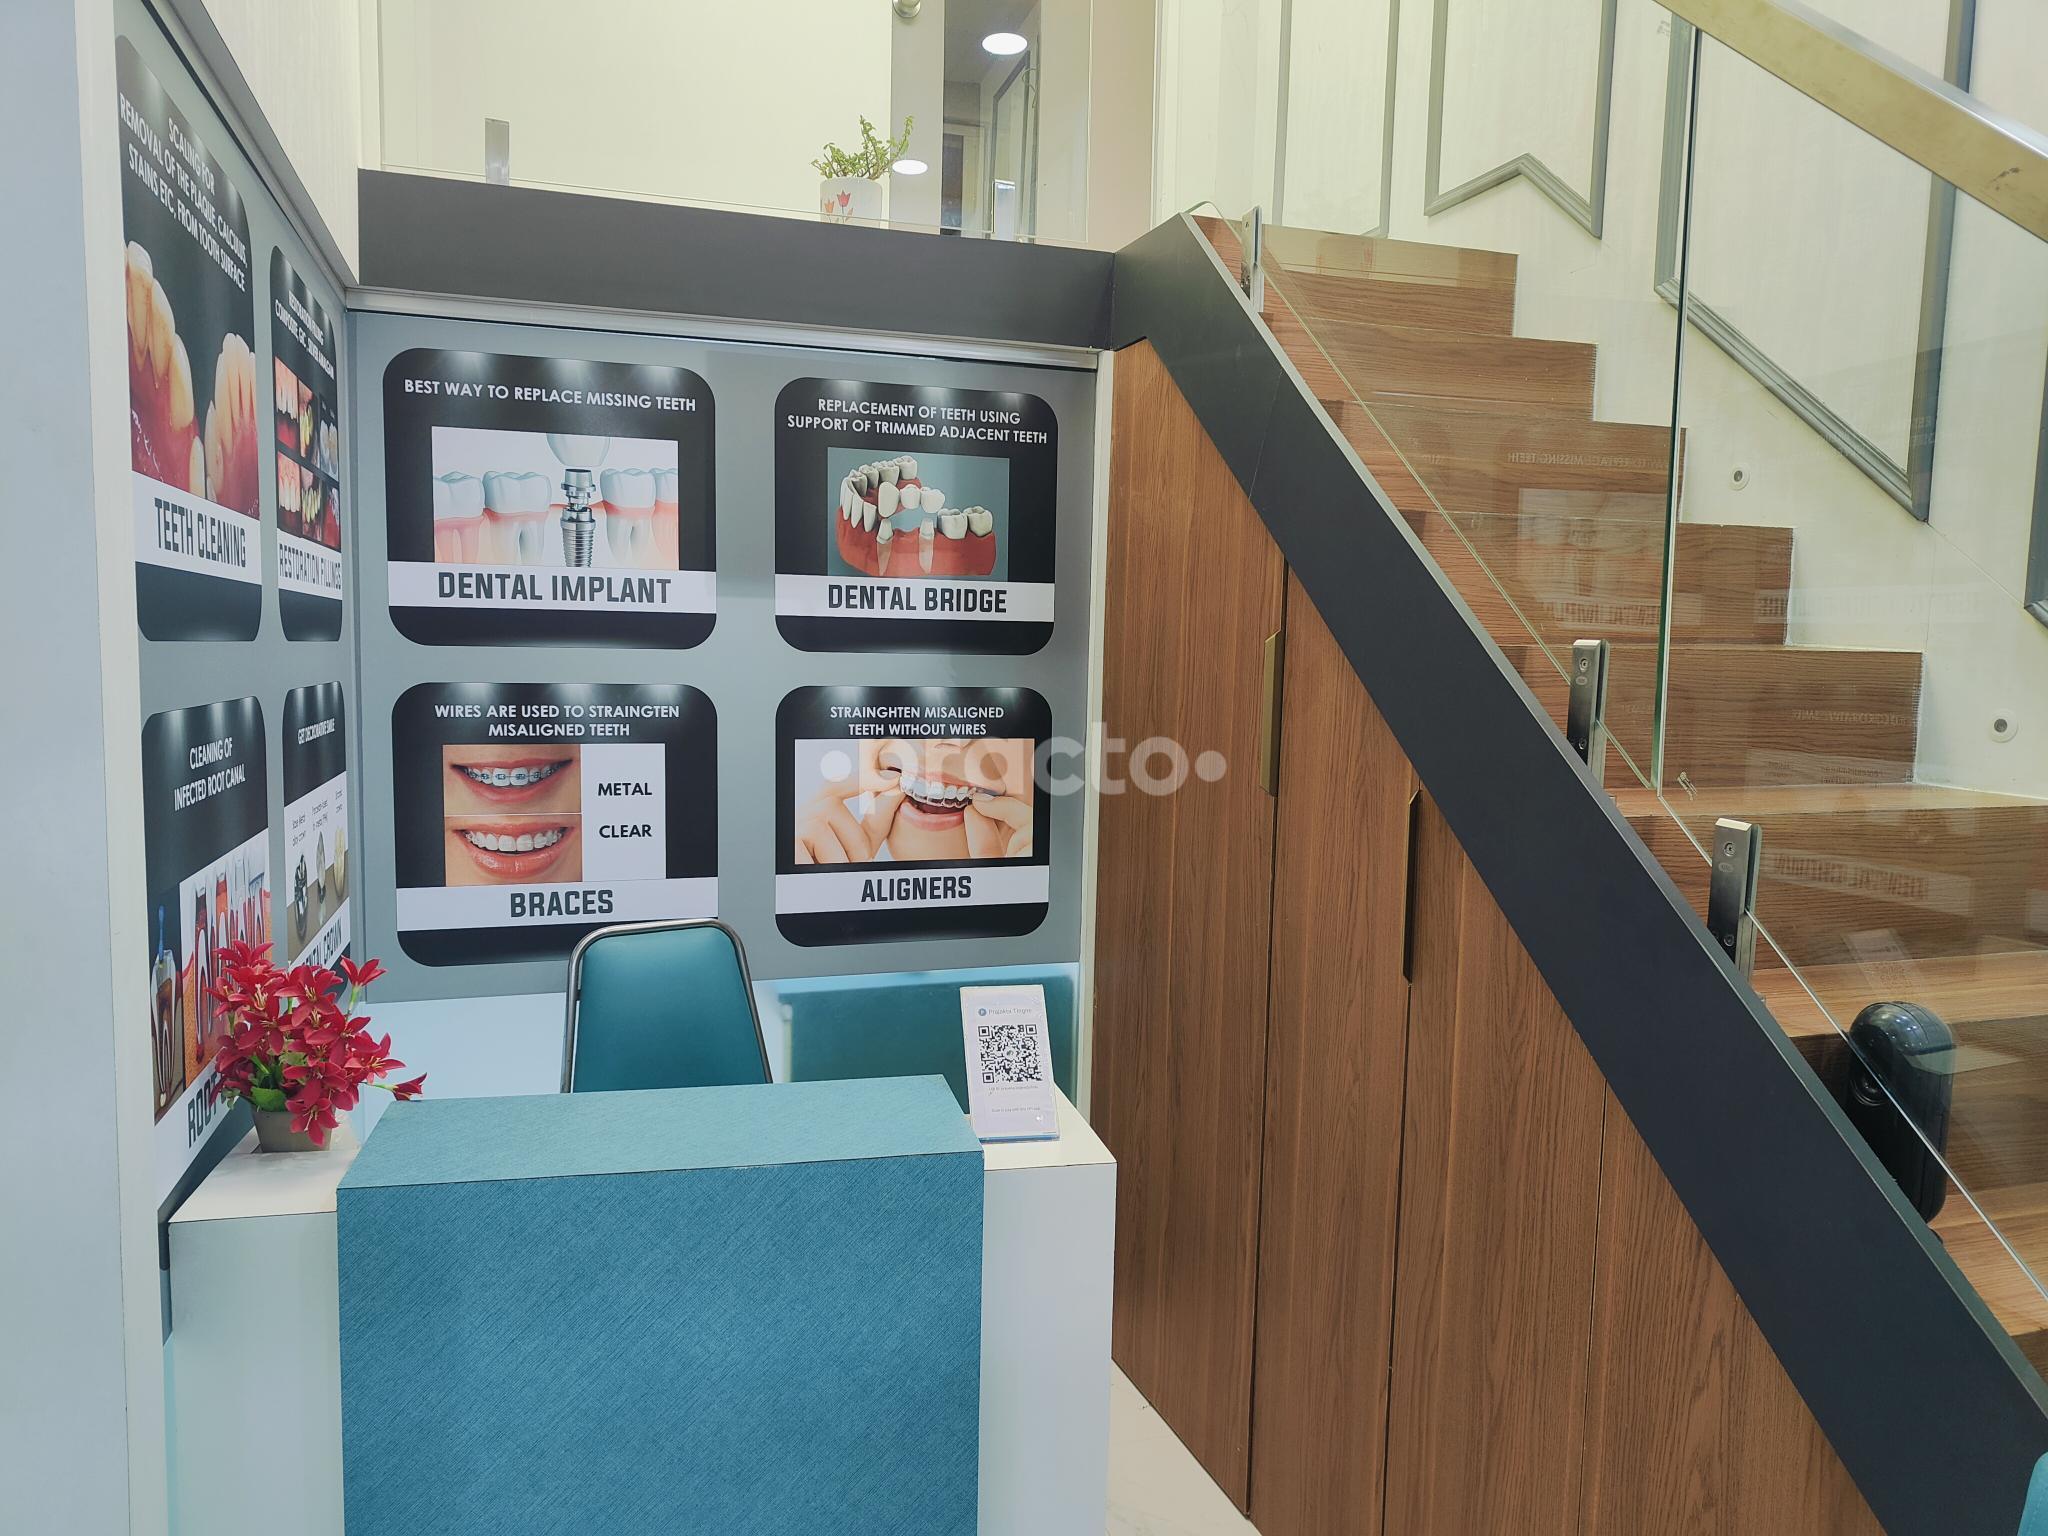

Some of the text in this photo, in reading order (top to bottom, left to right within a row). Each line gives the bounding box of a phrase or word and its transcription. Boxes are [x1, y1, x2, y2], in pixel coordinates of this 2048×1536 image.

[120, 92, 164, 166] REMOVAL
[164, 149, 175, 179] OF
[176, 162, 190, 197] THE
[190, 180, 217, 232] PLAQUE,
[169, 117, 215, 196] SCALING FOR
[128, 143, 245, 292] STAINS ETC, FROM TOOTH SURFACE
[404, 379, 696, 411] BEST WAY TO REPLACE MISSING TEETH
[818, 398, 1021, 425] REPLACEMENT OF TEETH USING
[787, 415, 1048, 444] SUPPORT OF TRIMMED ADJACENT TEETH
[154, 497, 246, 568] TEETH CLEANING
[280, 543, 320, 585] RESTORATION
[438, 571, 672, 604] DENTAL IMPLANT
[828, 584, 1007, 614] DENTAL BRIDGE
[434, 704, 680, 719] WIRES ARE USED TO STRAINGTEN
[830, 705, 1005, 719] STRAINGHTEN MISALIGNED
[488, 723, 630, 737] MISALIGNED TEETH
[848, 723, 987, 736] TEETH WITHOUT WIRES
[189, 737, 232, 770] CLEANING OF
[174, 763, 246, 811] INFECTED ROOT CANAL
[597, 782, 653, 796] METAL
[599, 824, 652, 838] CLEAR
[510, 889, 614, 917] BRACES
[860, 875, 972, 903] ALIGNERS
[187, 1071, 218, 1149] ROOT
